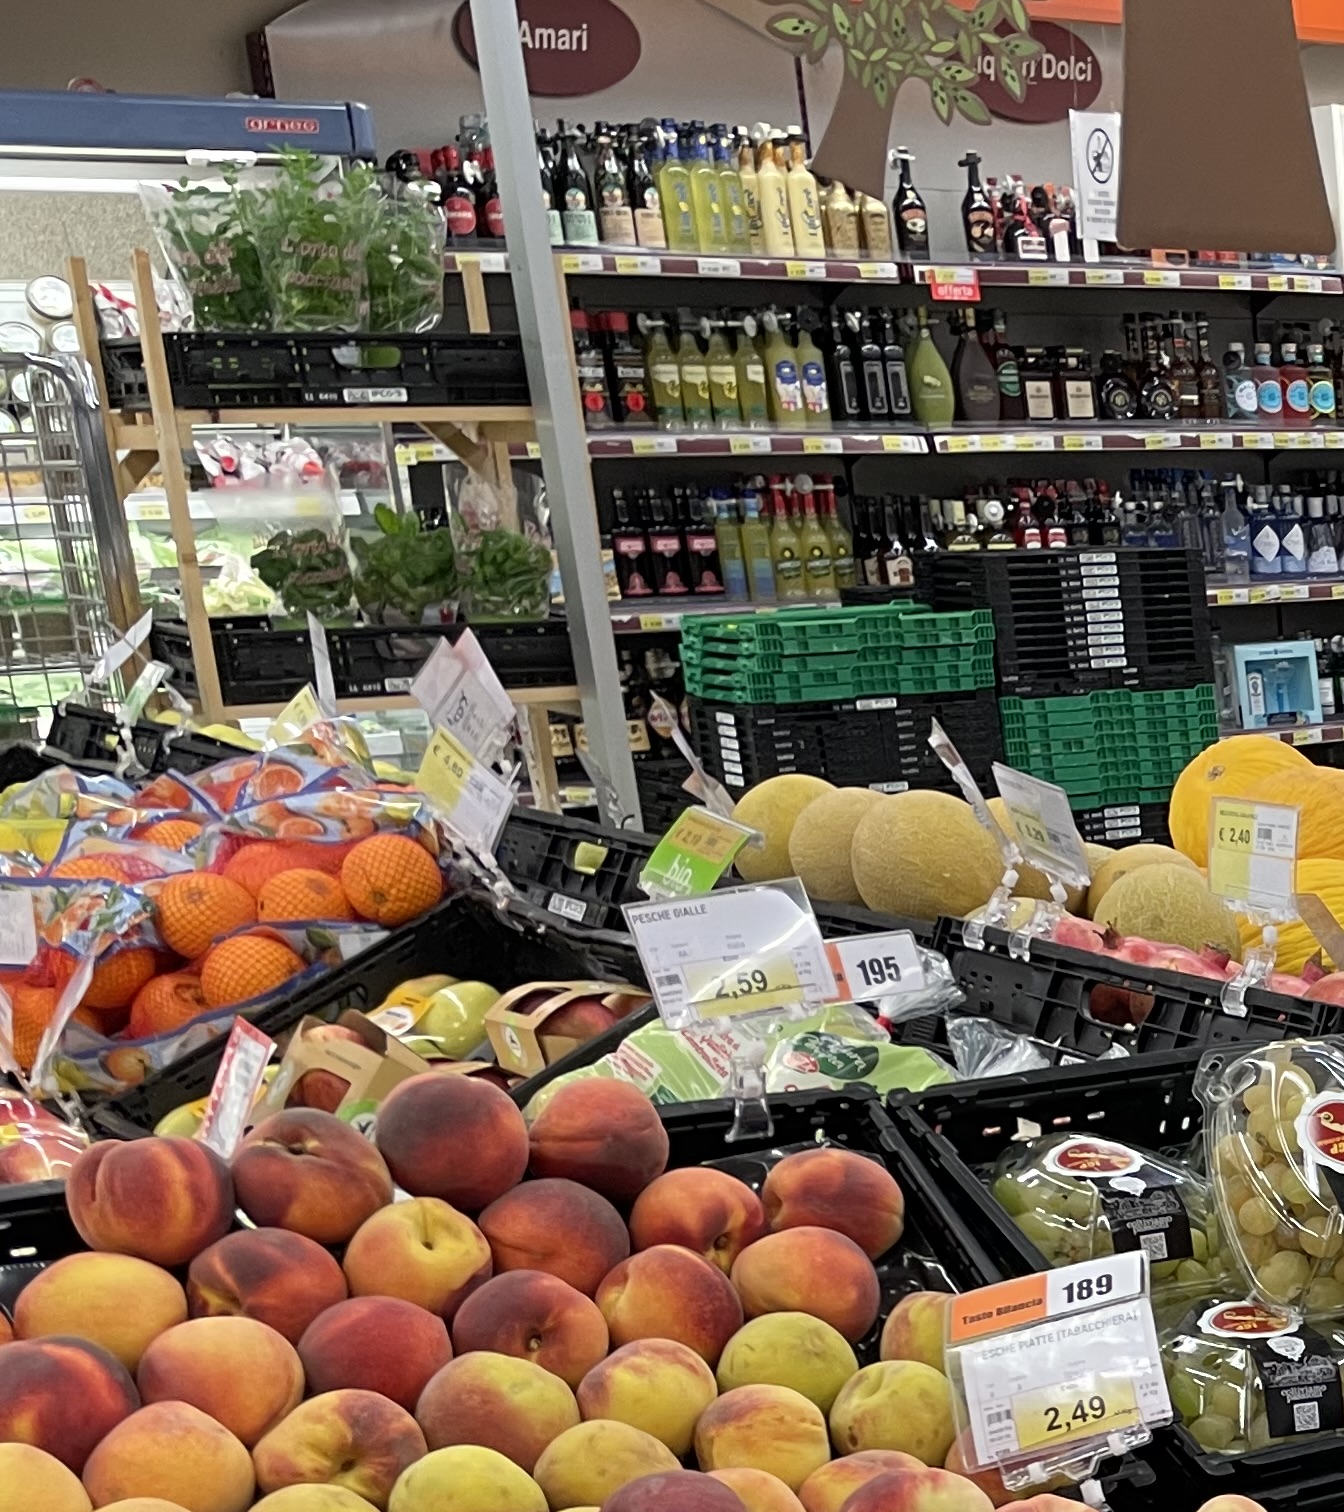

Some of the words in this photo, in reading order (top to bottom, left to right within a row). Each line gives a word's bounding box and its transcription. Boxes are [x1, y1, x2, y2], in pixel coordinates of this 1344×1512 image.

[518, 21, 588, 52] Amari
[1042, 53, 1093, 83] Dolci
[1230, 828, 1250, 845] 2,40
[632, 910, 671, 924] PESCHE
[674, 904, 707, 919] GIALLE
[712, 969, 768, 1000] 2,59
[856, 956, 901, 986] 195
[962, 1309, 993, 1325] Tasto
[996, 1297, 1043, 1316] Bilancia
[1062, 1274, 1113, 1303] 189
[1044, 1396, 1106, 1433] 2,49
